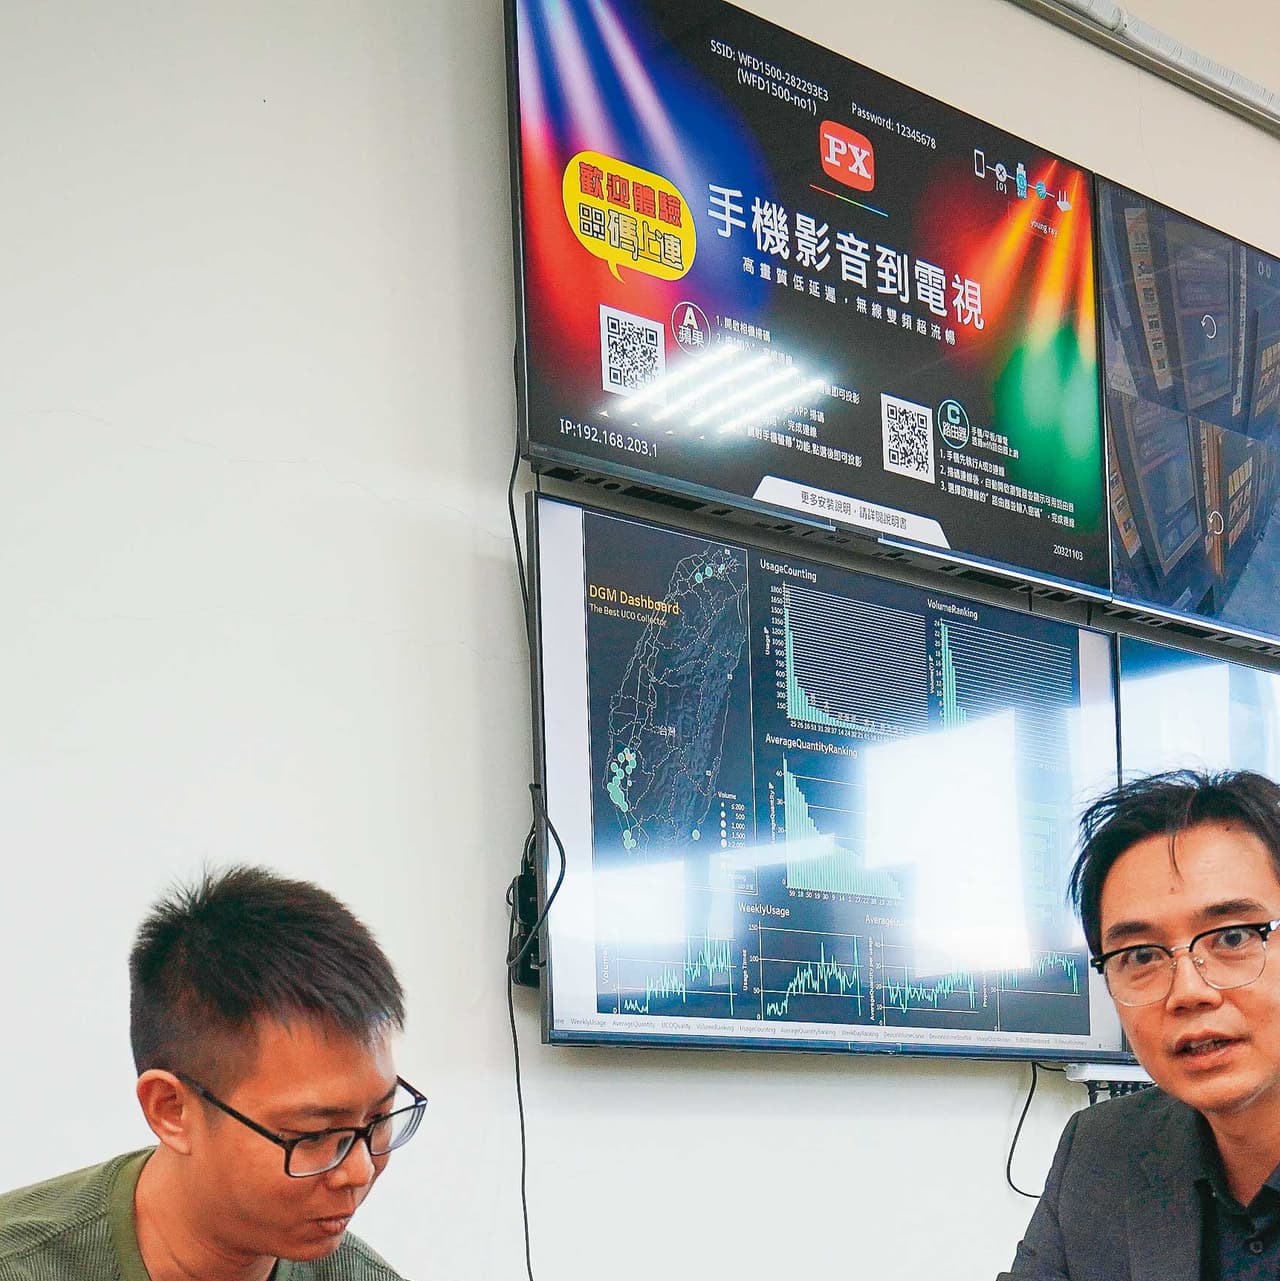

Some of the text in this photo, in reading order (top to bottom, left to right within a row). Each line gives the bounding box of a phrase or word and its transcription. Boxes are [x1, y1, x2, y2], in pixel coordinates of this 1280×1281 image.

[710, 39, 830, 103] SSID: WFD1500-282293E3
[737, 68, 817, 116] (WFD1500-no1)
[851, 102, 937, 150] Password: 12345678
[823, 133, 873, 180] PX
[578, 161, 683, 229] 歡迎體驗
[707, 183, 986, 331] 手機影音到電視
[682, 306, 698, 330] A
[677, 325, 705, 348] 蘋果
[946, 404, 960, 425] C
[559, 418, 658, 458] IP:192.168.203.1
[942, 420, 968, 443] 路由器
[759, 558, 818, 583] UsageCounting
[589, 584, 680, 615] DGM Dashboard
[926, 598, 978, 621] VolumeRanking
[589, 602, 668, 628] The Best UCO Collector
[765, 733, 859, 759] AverageQuantityRanking
[738, 902, 790, 917] WeeklyUsage
